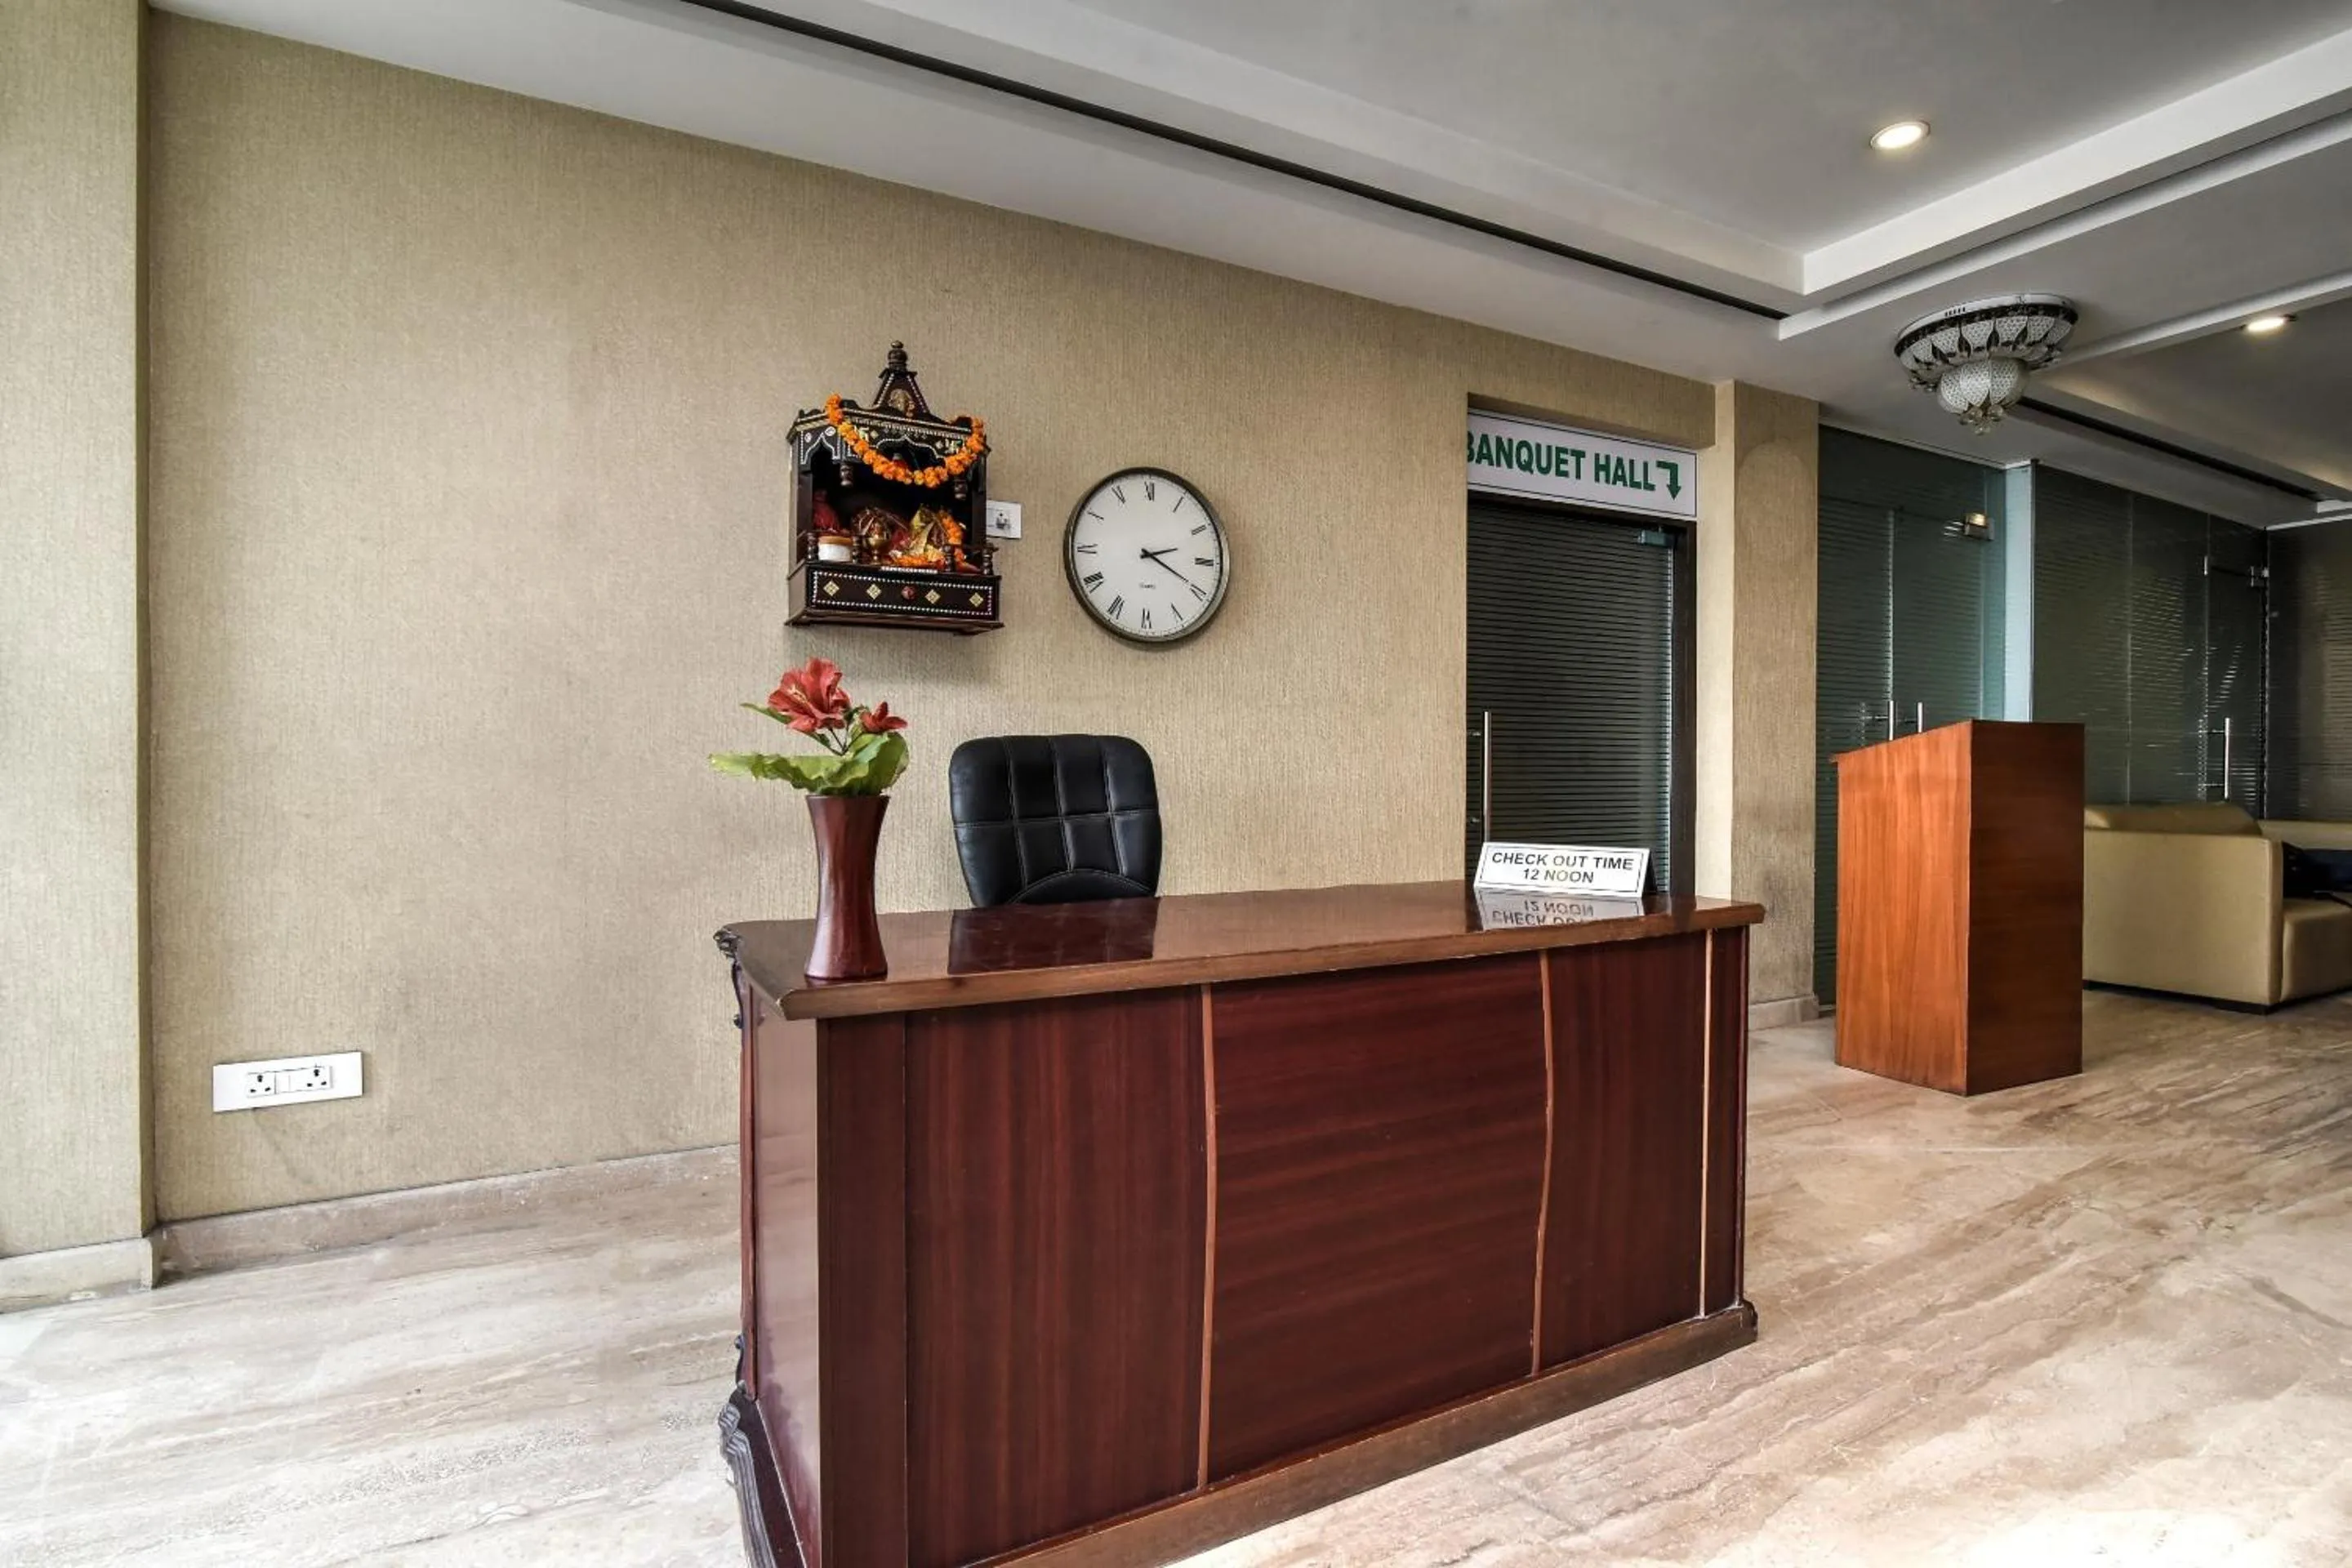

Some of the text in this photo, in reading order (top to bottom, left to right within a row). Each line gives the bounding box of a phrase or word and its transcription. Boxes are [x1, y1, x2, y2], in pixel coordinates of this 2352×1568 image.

[1594, 452, 1656, 491] HALL
[1491, 852, 1634, 871] CHECK OUT TIME
[1523, 868, 1594, 884] 12 NOON
